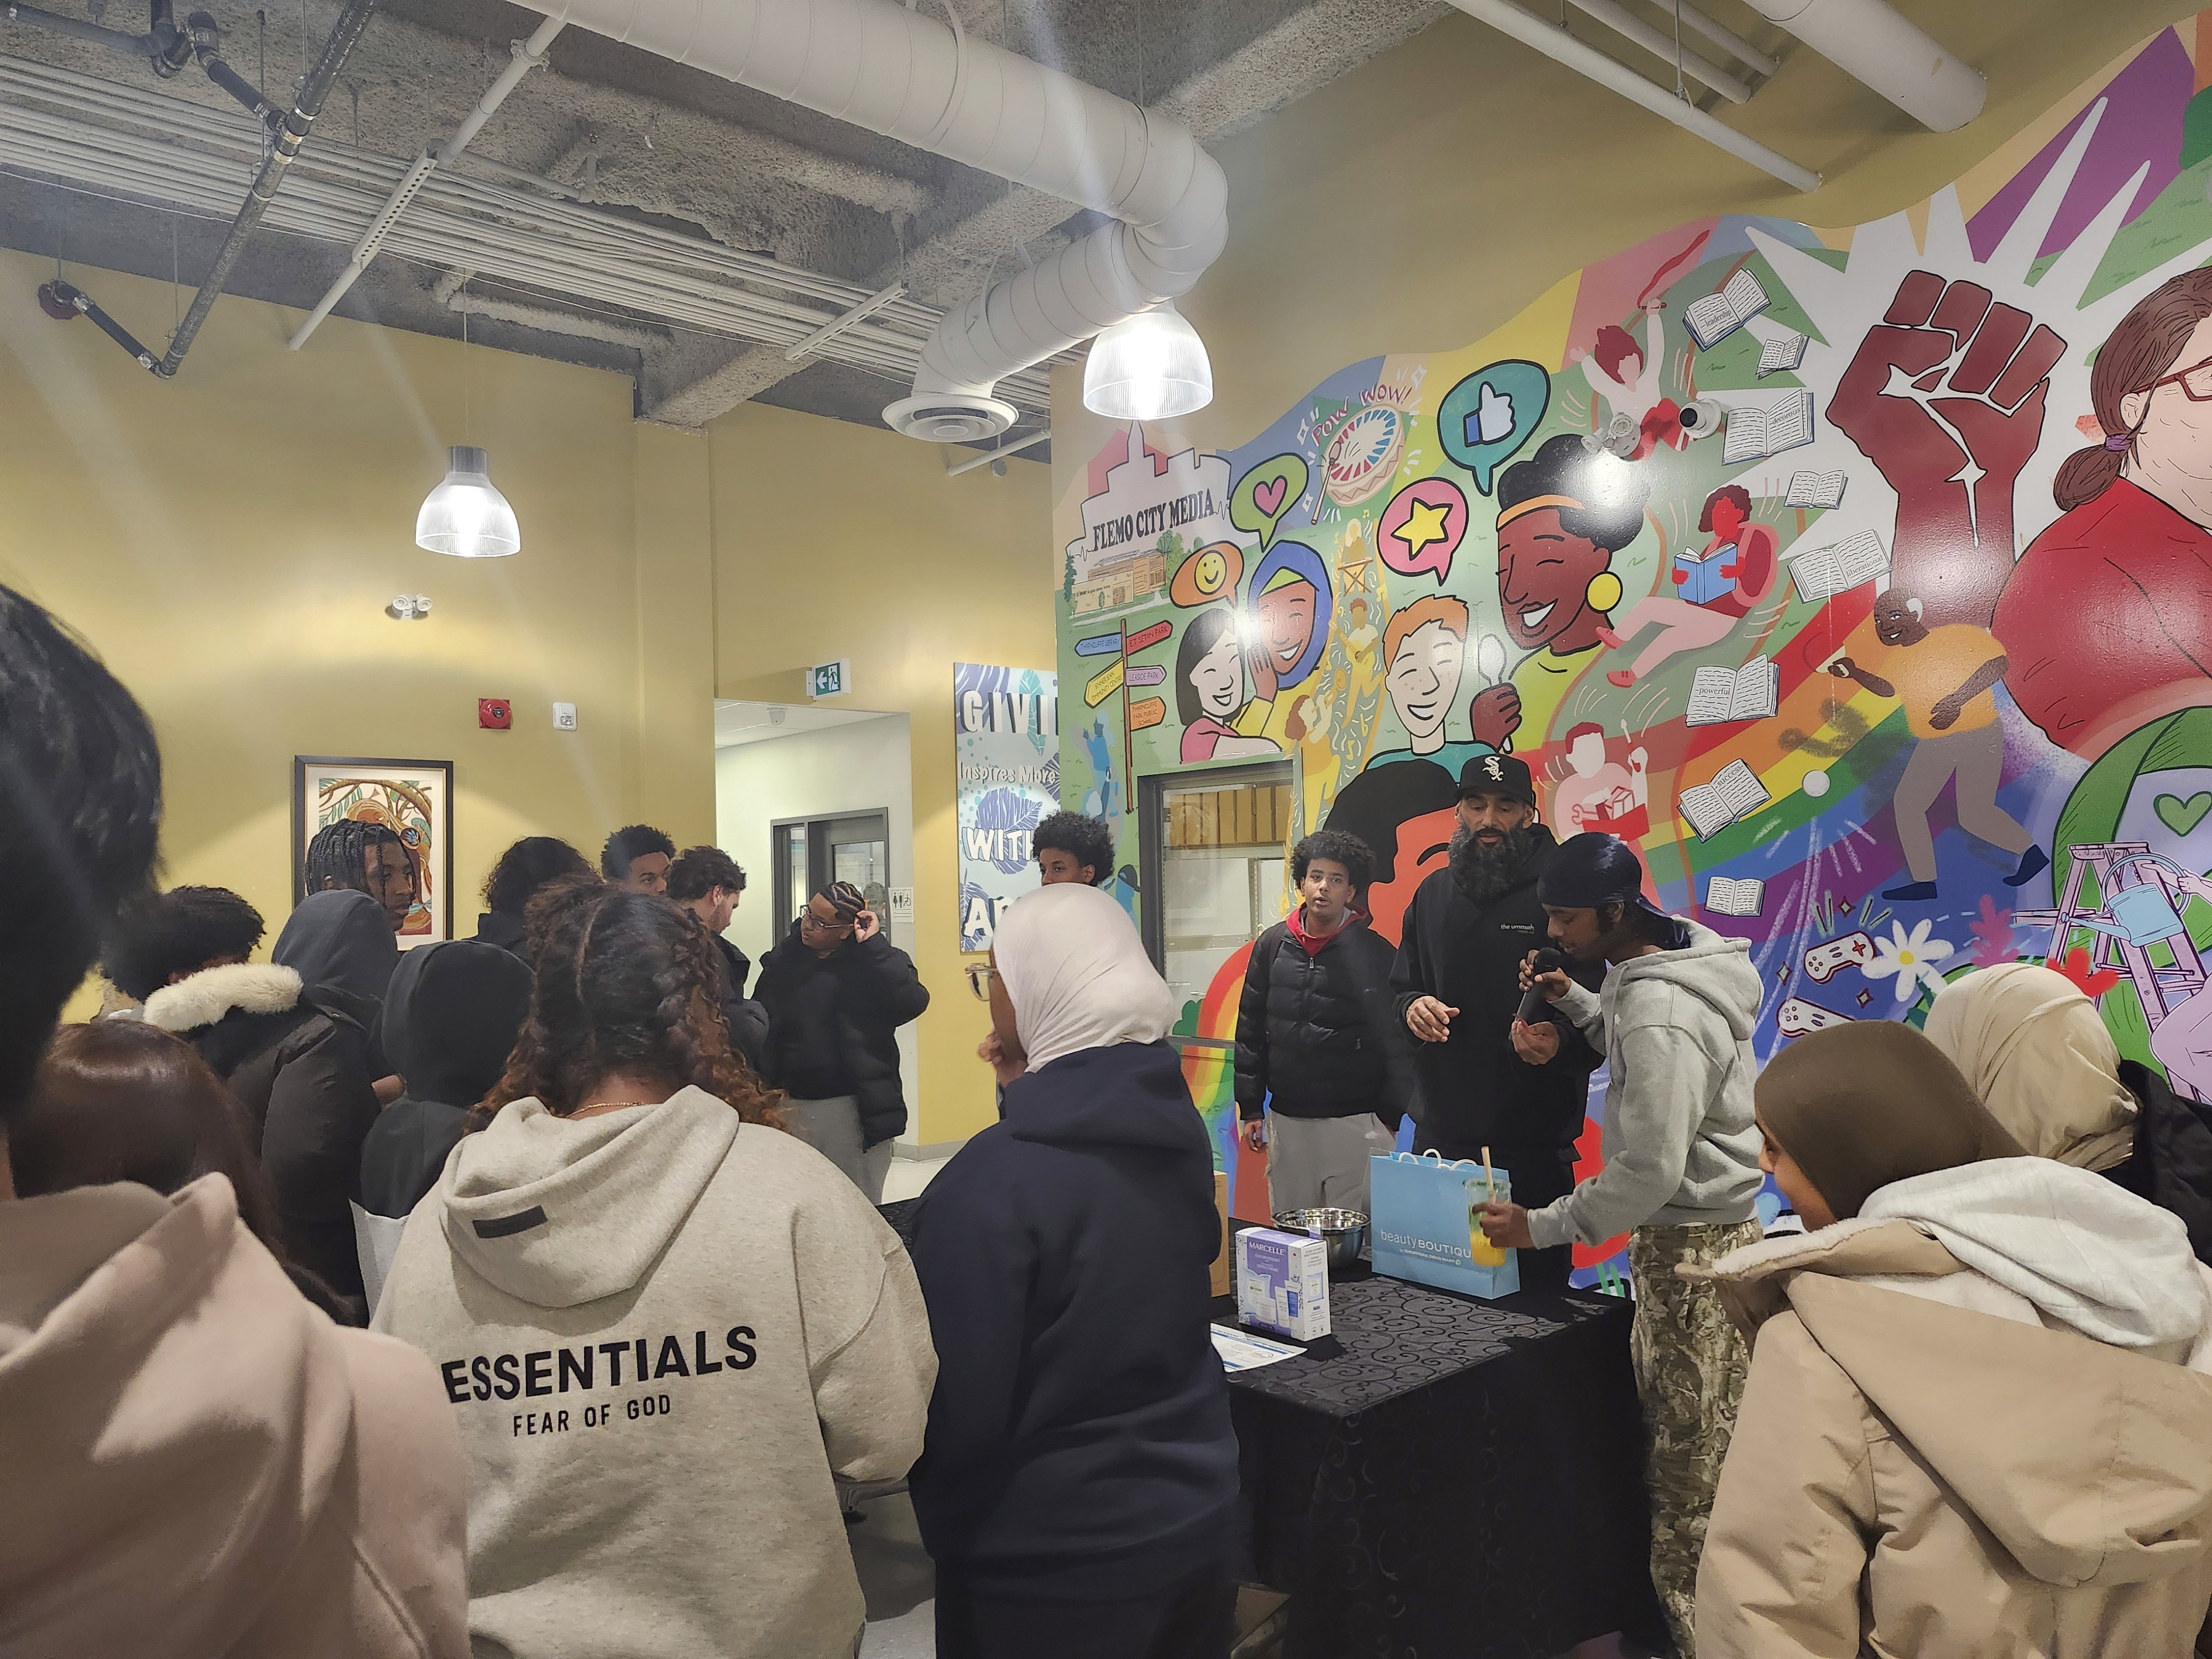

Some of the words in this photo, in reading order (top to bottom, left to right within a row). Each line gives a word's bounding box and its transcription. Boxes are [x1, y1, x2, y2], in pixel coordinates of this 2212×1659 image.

[1704, 309, 1731, 327] leadership
[1312, 396, 1349, 447] POW
[1360, 384, 1412, 406] WOW!
[1772, 407, 1801, 425] decorous
[1093, 514, 1133, 551] FLEMO
[1136, 502, 1166, 538] CITY
[1169, 488, 1214, 529] MEDIA
[1846, 555, 1884, 577] liberational
[1129, 638, 1137, 647] ET
[1138, 631, 1154, 643] SETON
[1155, 625, 1168, 636] PARK
[1129, 672, 1146, 681] LEASIDE
[959, 689, 1058, 736] GIVI
[958, 761, 1016, 784] Inspires
[1019, 764, 1057, 784] More
[1249, 1241, 1285, 1256] MARCELLE
[441, 1326, 757, 1404] ESSENTIALS
[513, 1410, 569, 1437] FEAR
[585, 1404, 611, 1427] OF
[627, 1394, 671, 1420] GOD
